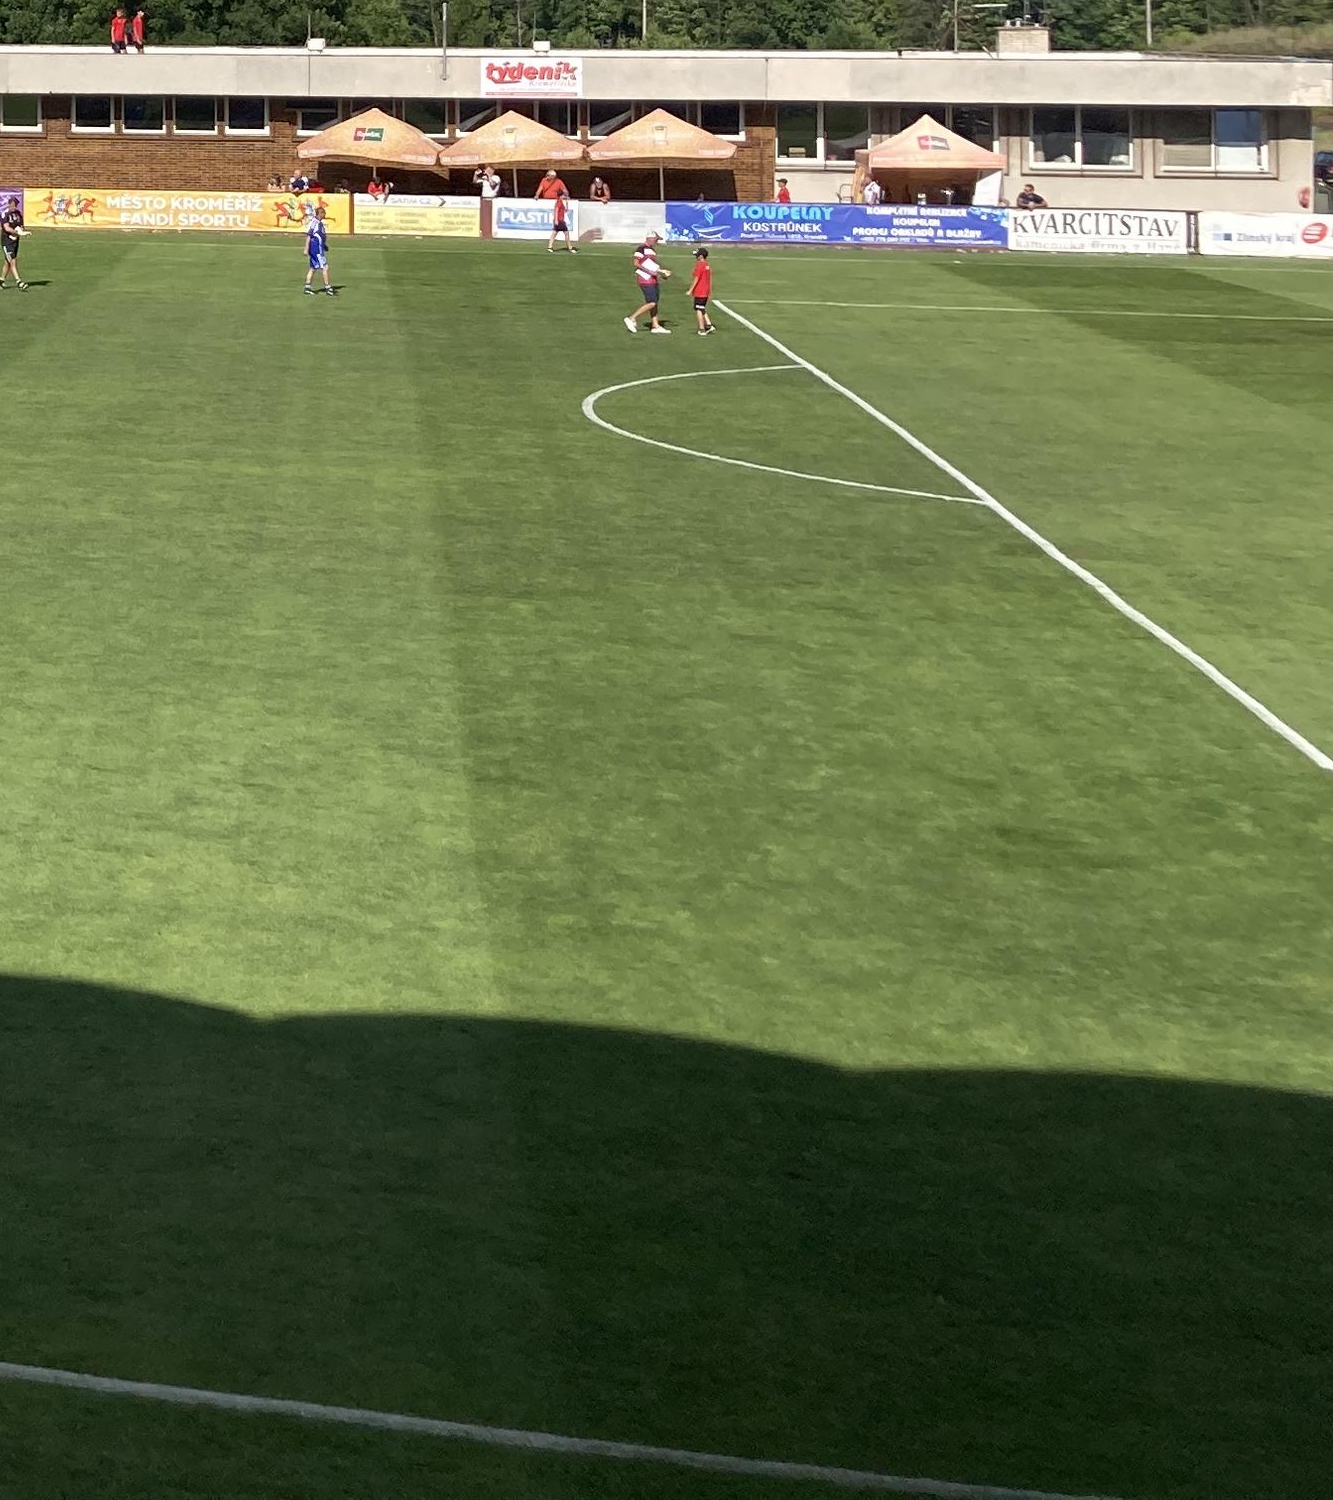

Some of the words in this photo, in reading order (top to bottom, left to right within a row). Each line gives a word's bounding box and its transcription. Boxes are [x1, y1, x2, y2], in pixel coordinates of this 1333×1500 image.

[106, 193, 166, 210] MĚSTO
[171, 194, 264, 212] KROMĚŘÍŽ
[120, 210, 175, 226] FANDÍ
[178, 213, 250, 228] SPORTU
[732, 205, 835, 221] KOUPELNY
[1012, 212, 1180, 237] KVARCITSTAV
